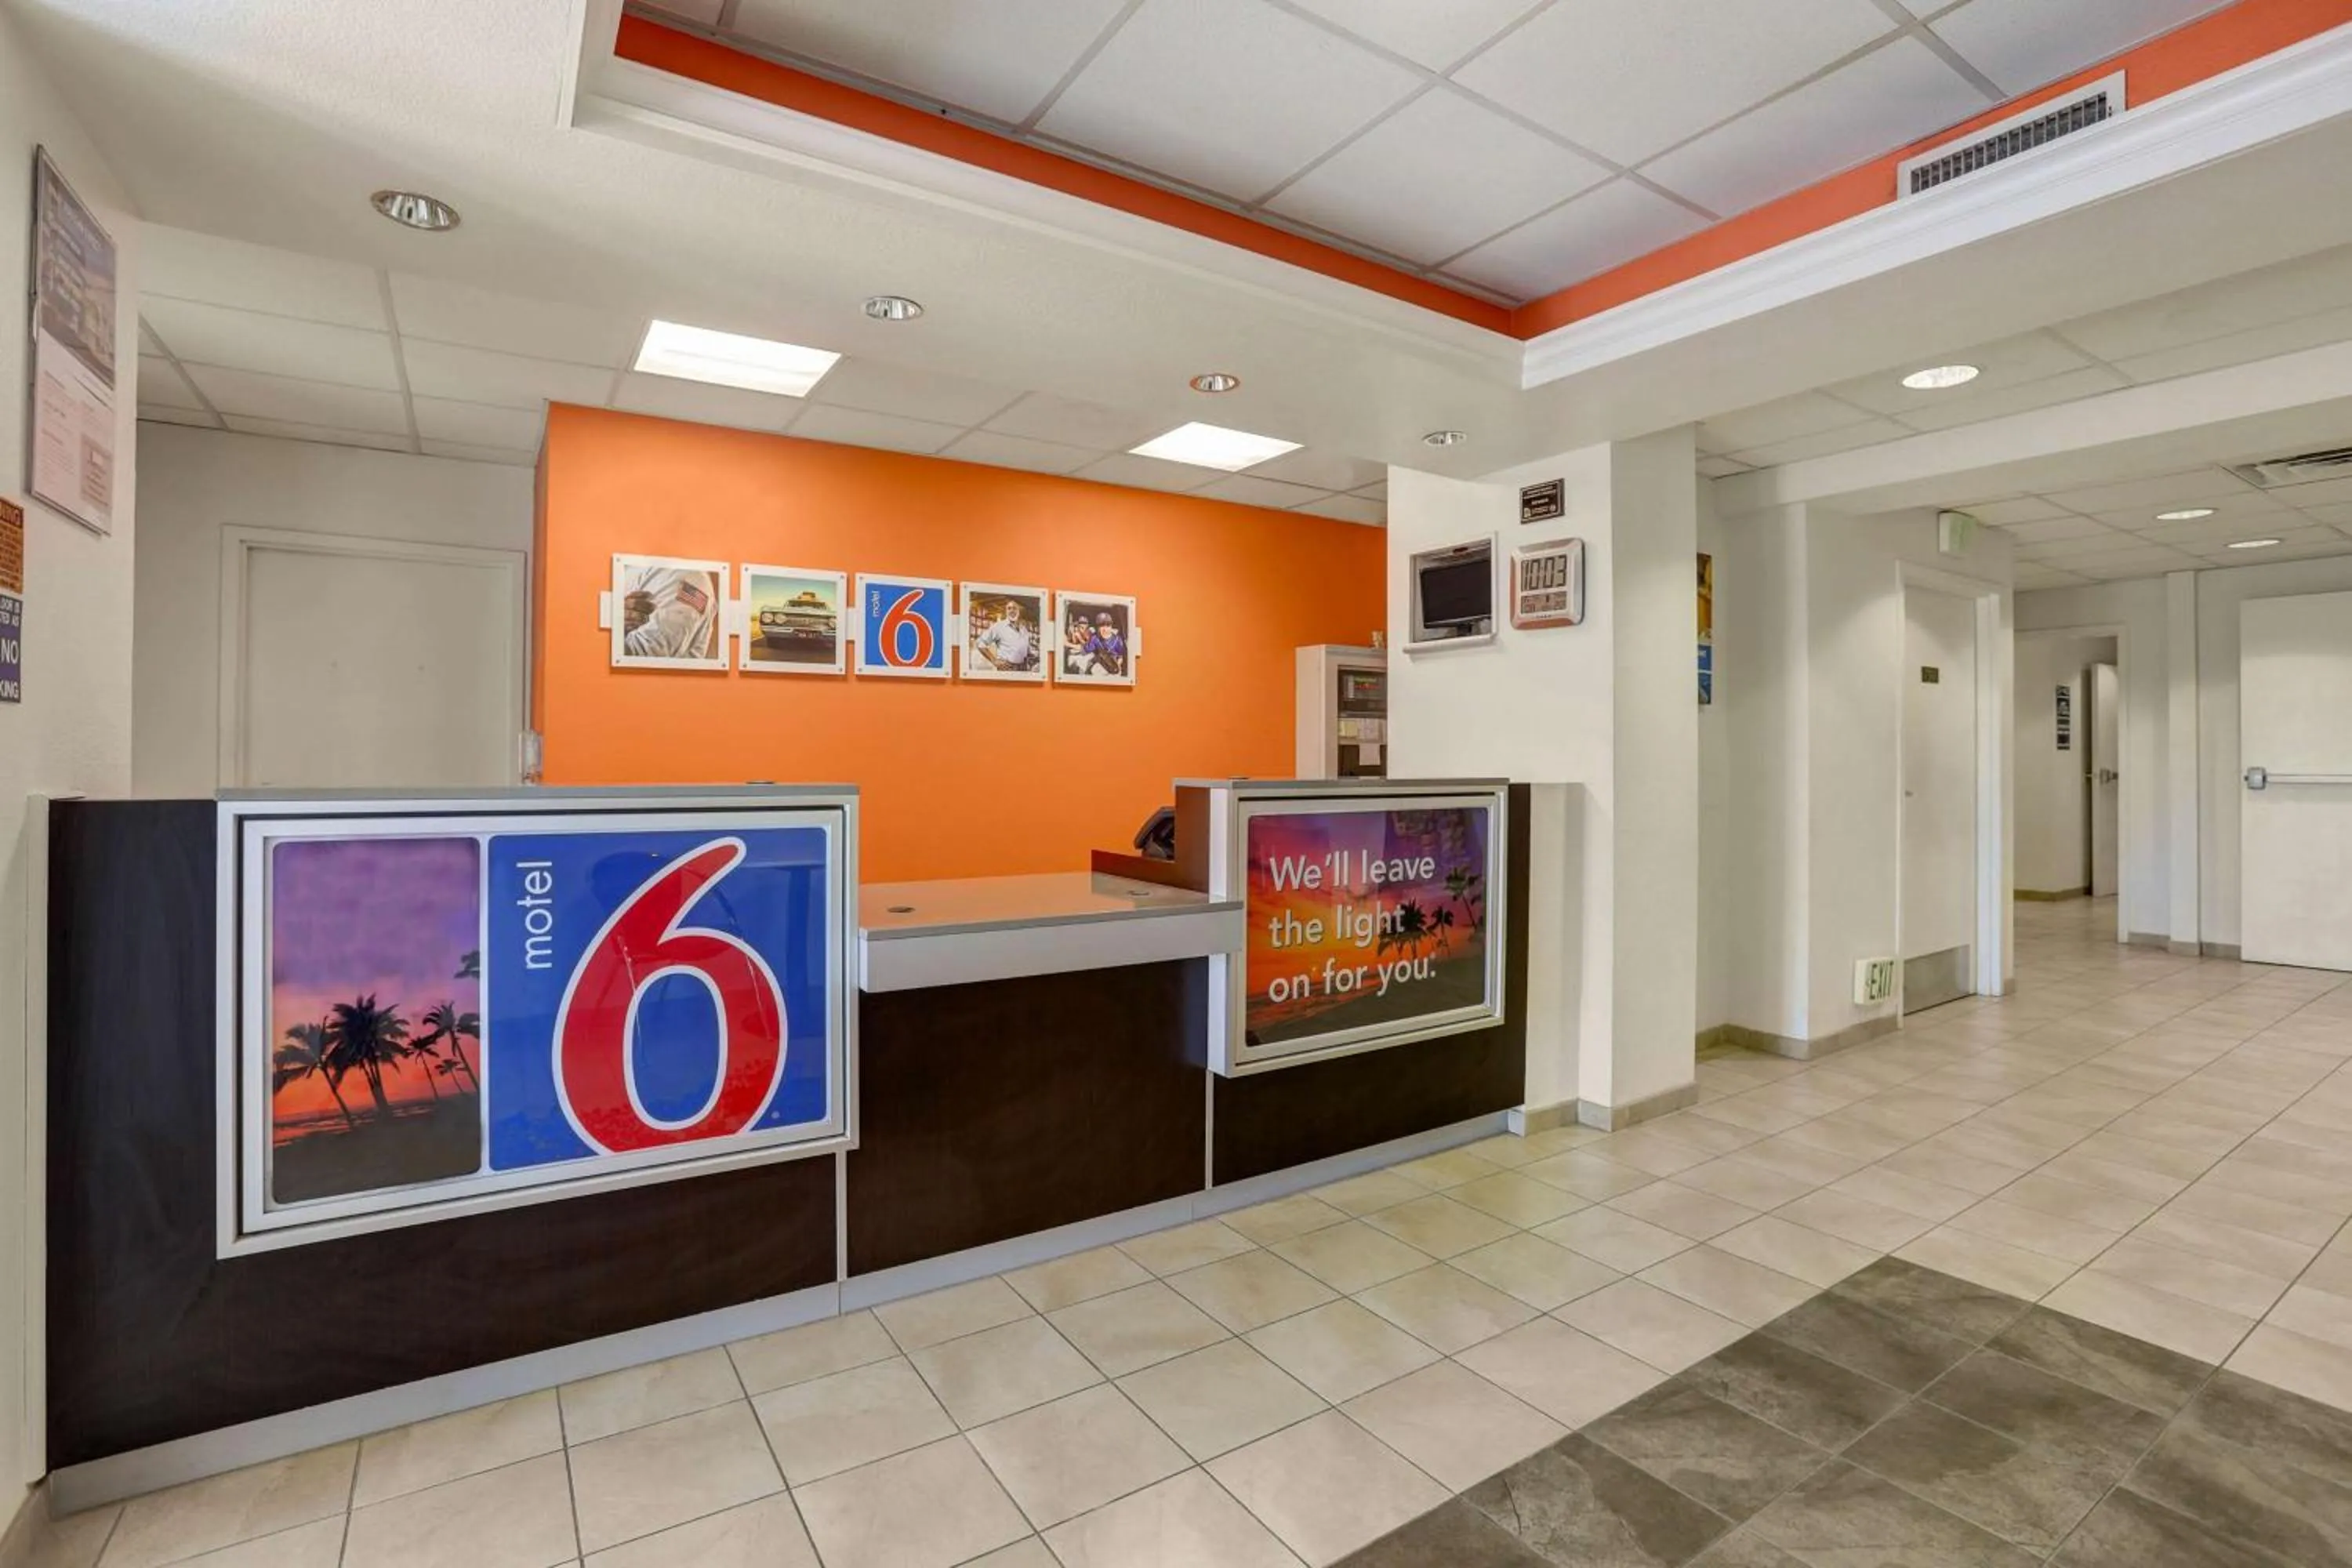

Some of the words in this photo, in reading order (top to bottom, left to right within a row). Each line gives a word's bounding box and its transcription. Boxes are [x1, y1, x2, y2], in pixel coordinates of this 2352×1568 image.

[1, 637, 19, 665] NO
[871, 590, 880, 618] motel
[879, 589, 935, 668] 6
[1269, 851, 1349, 891] We'll
[1362, 849, 1436, 884] leave
[1269, 909, 1323, 948] the
[1336, 901, 1406, 948] light
[516, 861, 552, 969] motel
[552, 837, 788, 1156] 6
[1269, 973, 1310, 1004] on
[1323, 957, 1368, 994] for
[1376, 956, 1436, 997] you.
